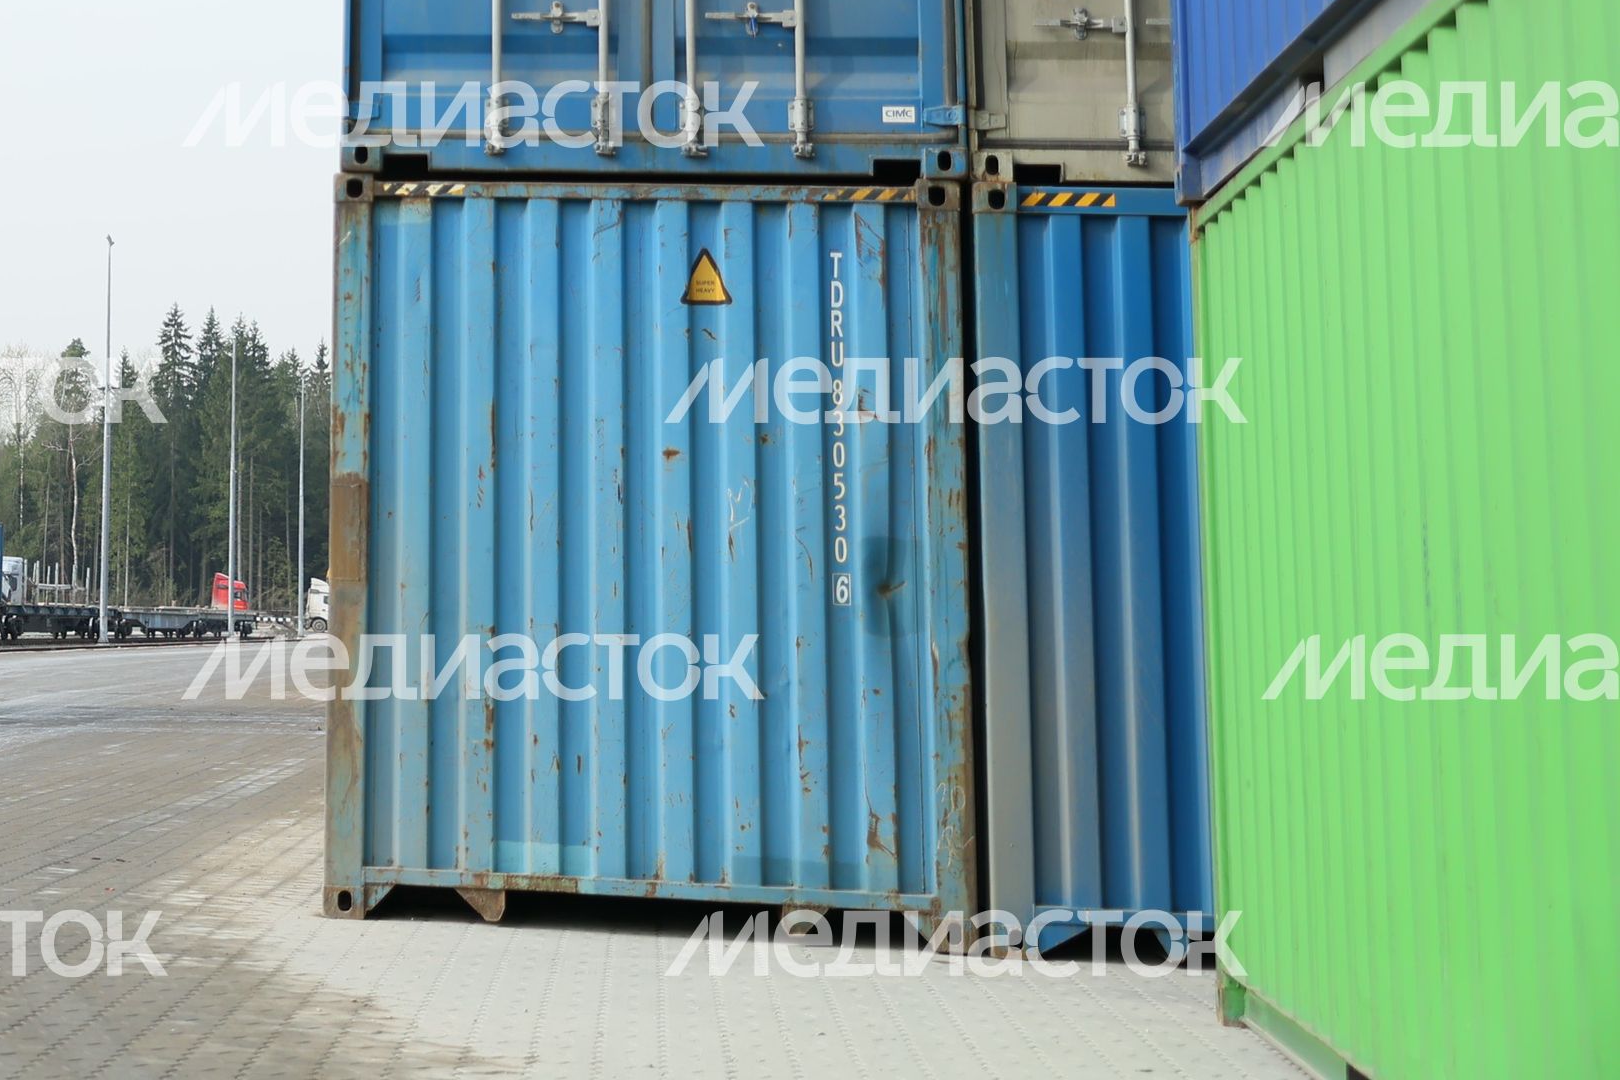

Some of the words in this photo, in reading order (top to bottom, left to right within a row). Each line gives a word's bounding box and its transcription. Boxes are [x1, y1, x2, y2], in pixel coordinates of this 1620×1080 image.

[885, 109, 912, 118] CIMC
[829, 251, 845, 368] TDRU
[831, 379, 849, 565] 830530
[834, 575, 850, 604] 6
